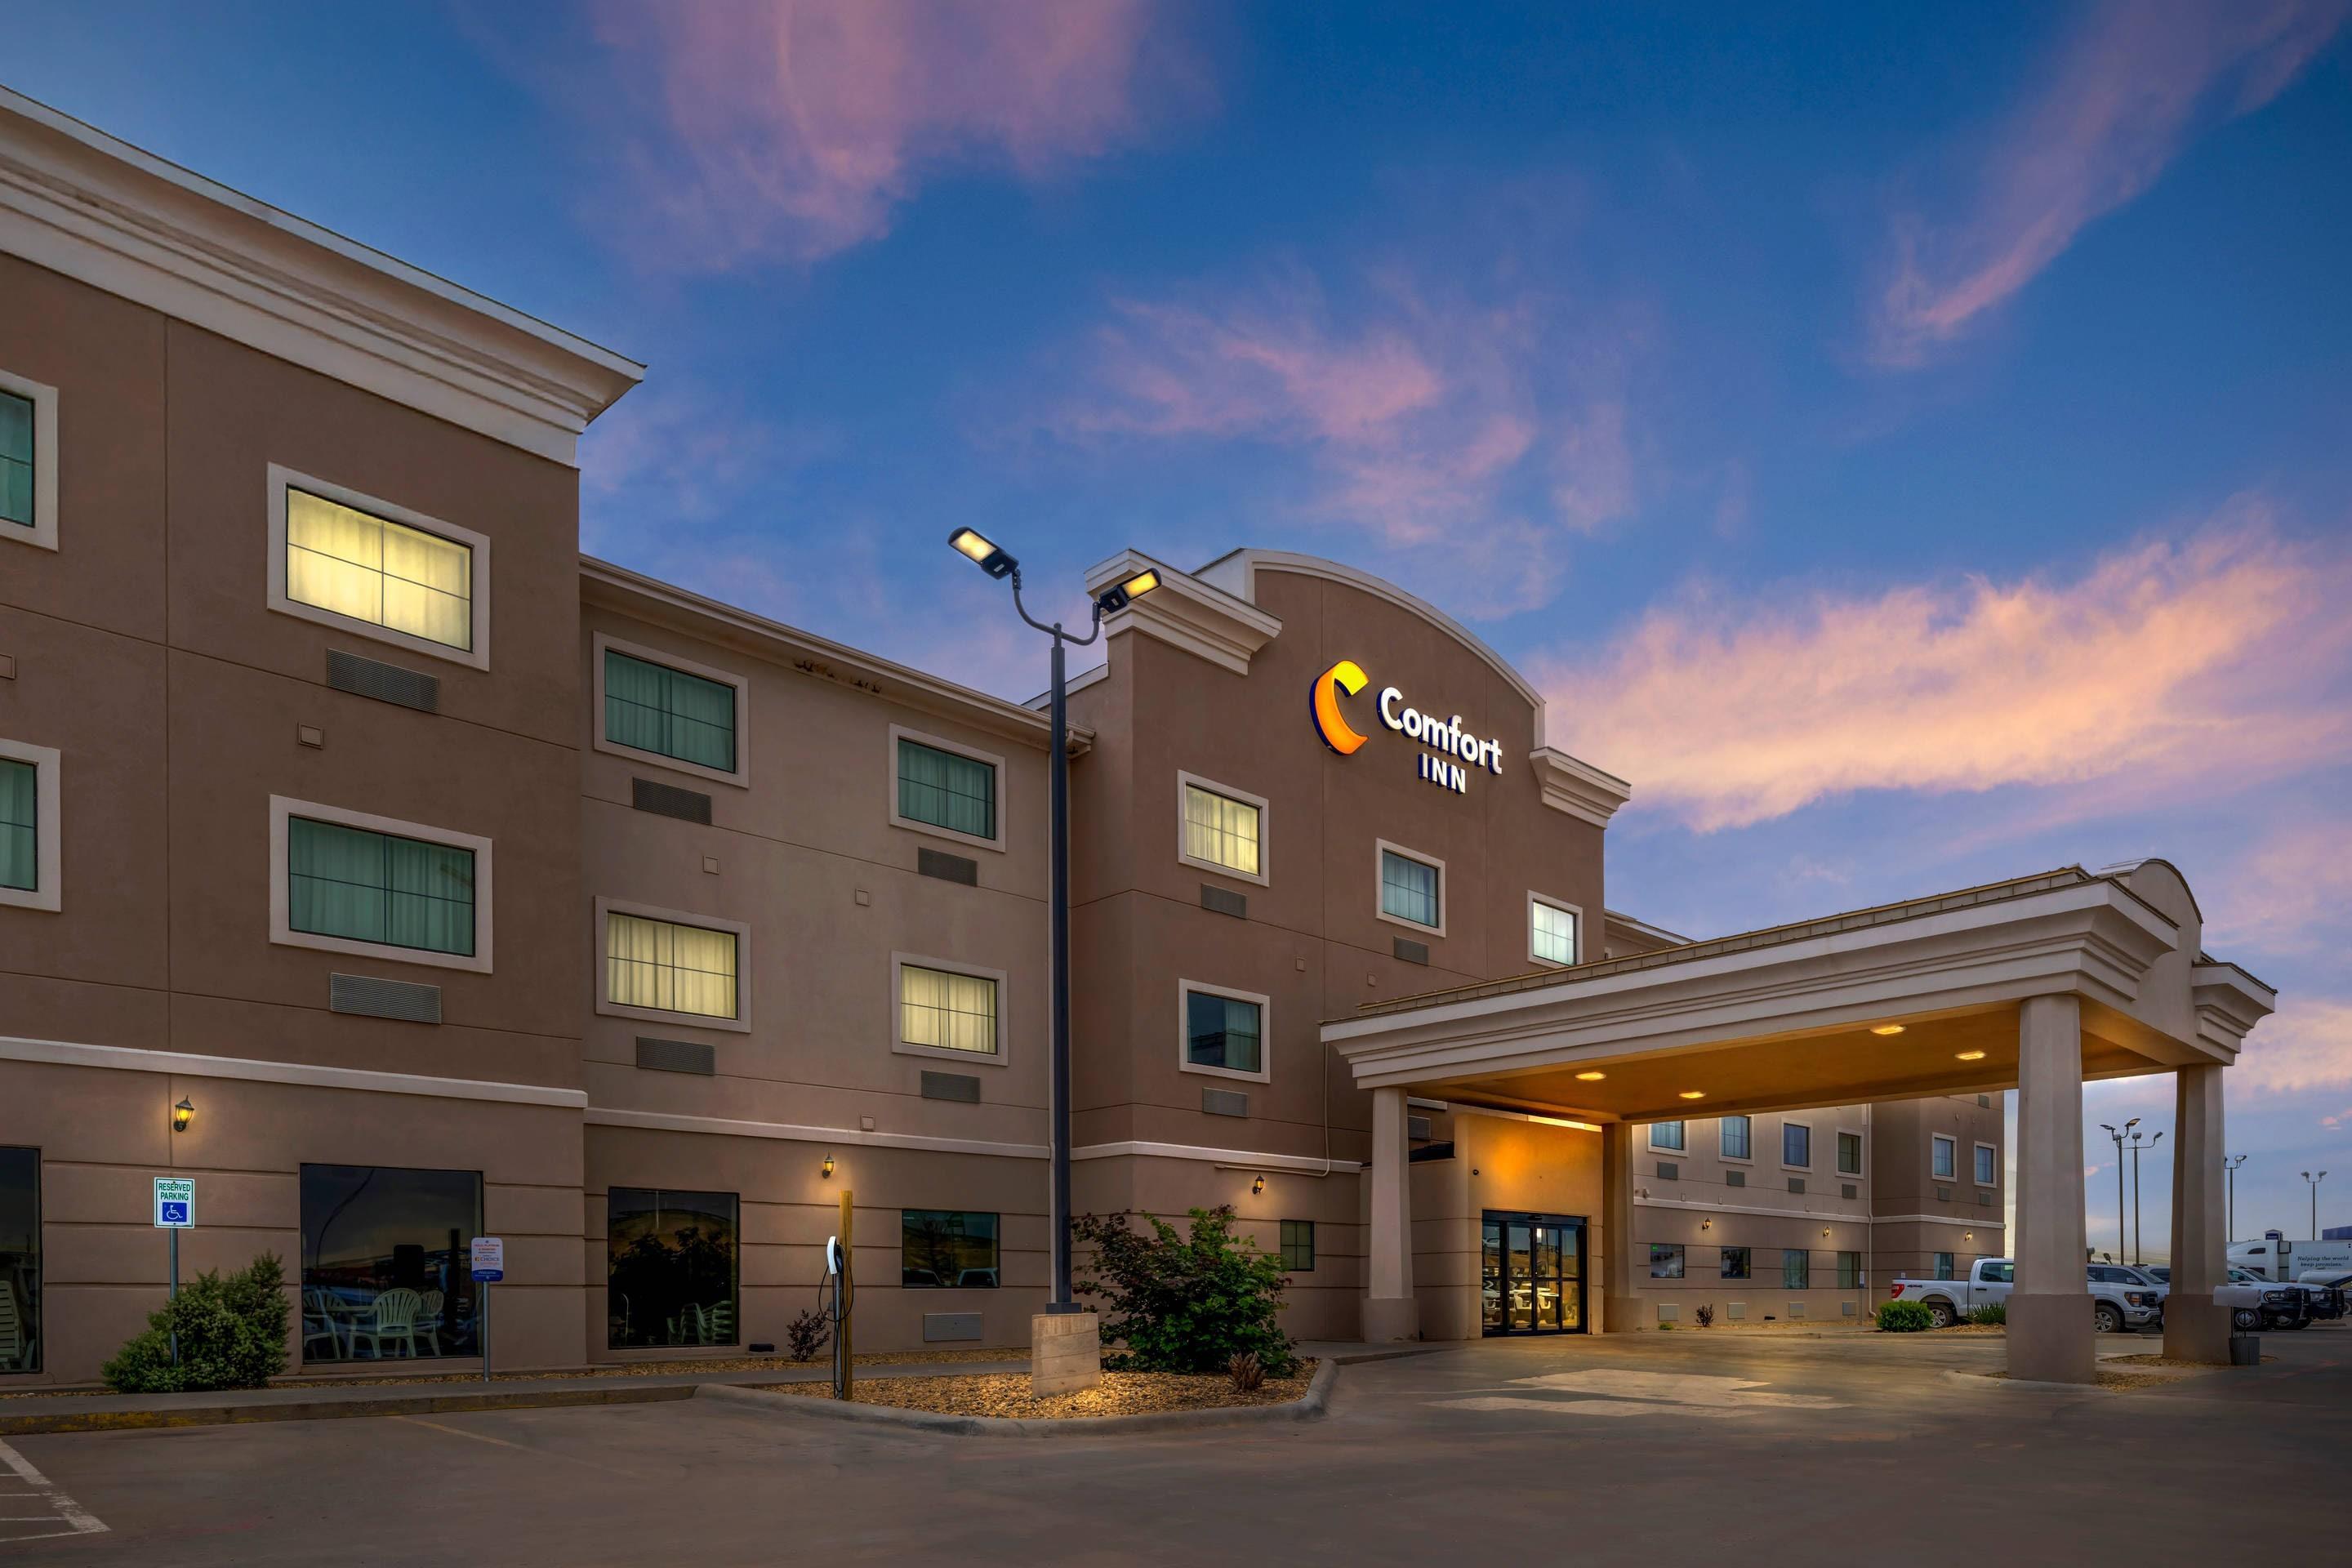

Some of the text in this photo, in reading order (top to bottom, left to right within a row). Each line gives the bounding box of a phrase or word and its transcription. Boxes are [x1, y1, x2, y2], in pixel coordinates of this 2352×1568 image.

[1376, 687, 1502, 774] Comfort
[1418, 752, 1466, 794] INN
[158, 1183, 190, 1192] RESERVED
[161, 1192, 189, 1200] PARKING
